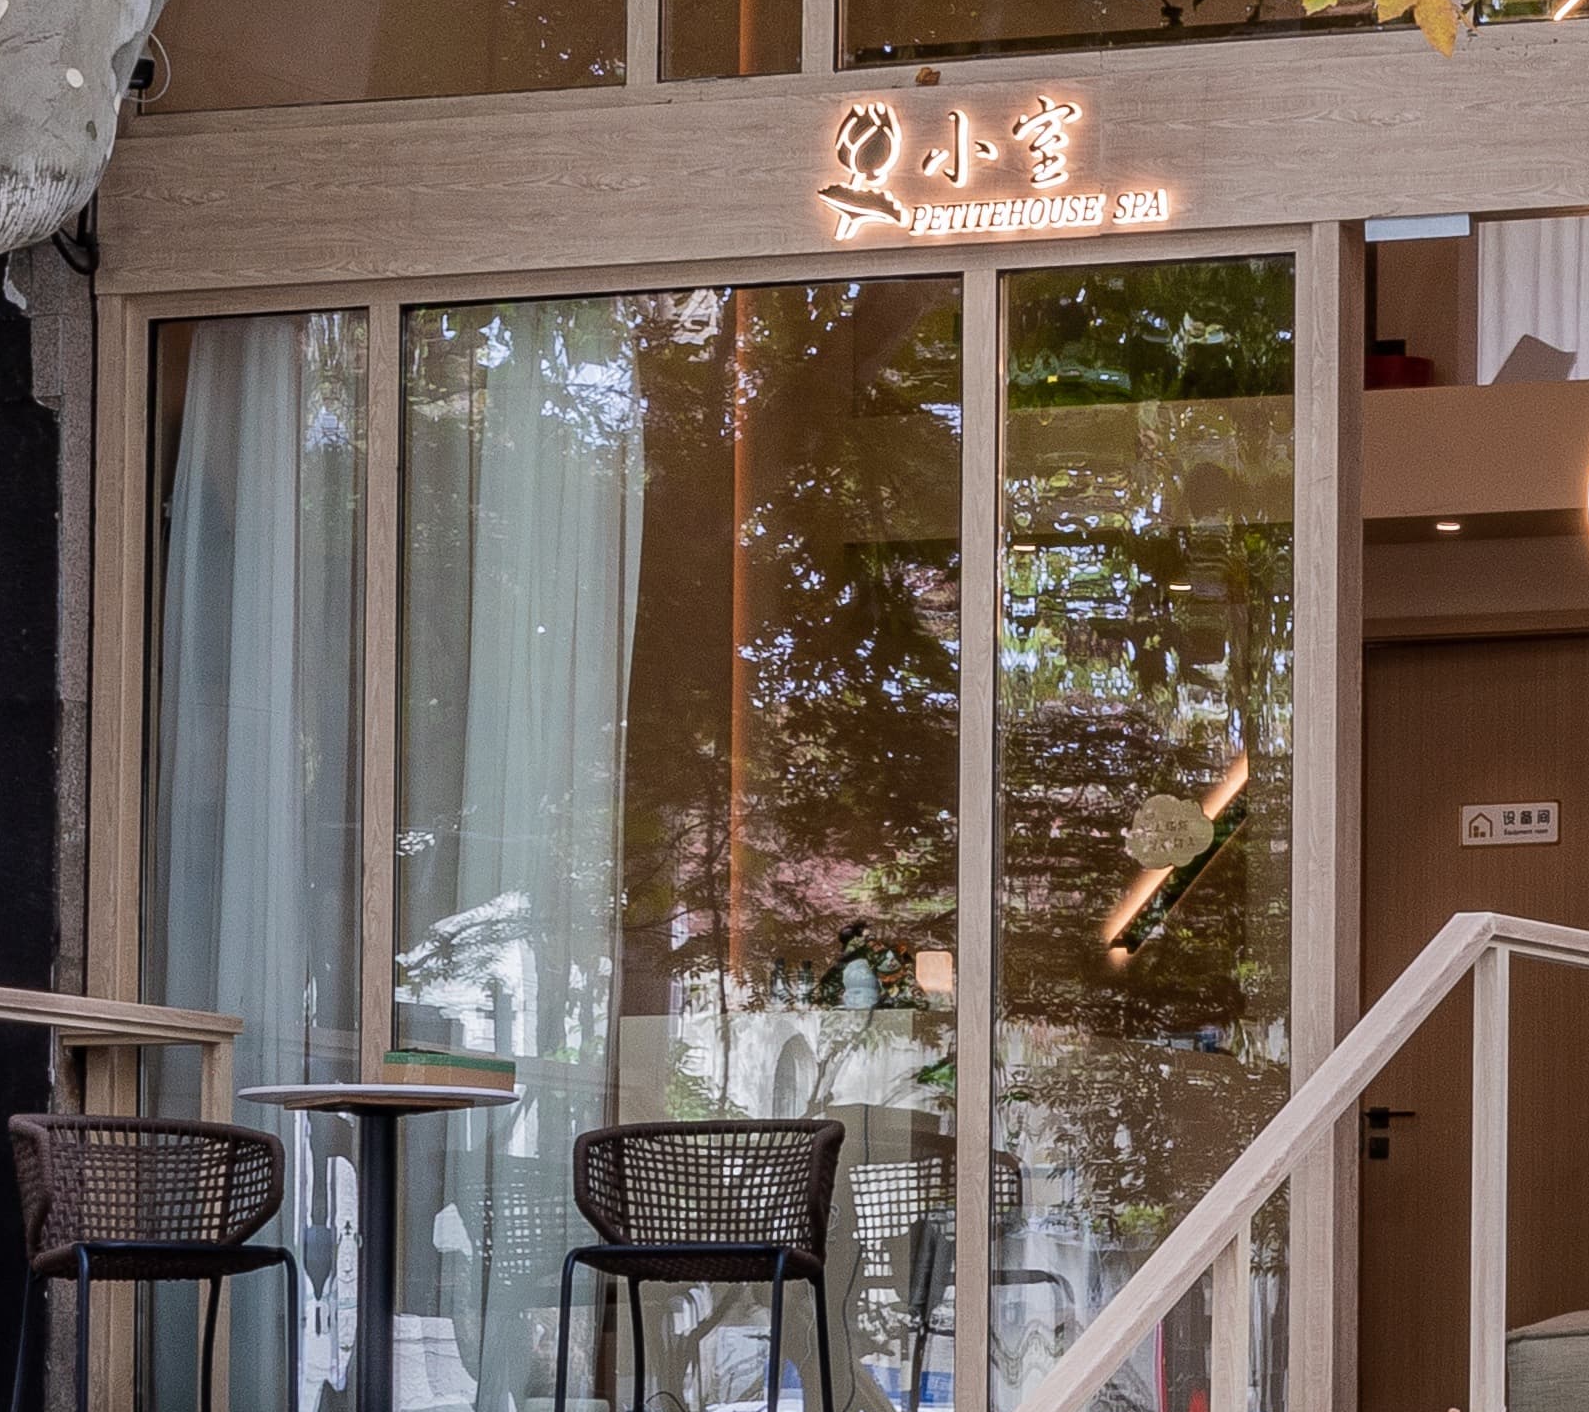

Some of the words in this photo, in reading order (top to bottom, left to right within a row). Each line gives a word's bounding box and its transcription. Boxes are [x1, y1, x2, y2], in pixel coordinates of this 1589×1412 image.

[921, 94, 1083, 188] 小室
[910, 194, 1106, 236] PETITEHOUSE
[1112, 188, 1169, 224] SPA
